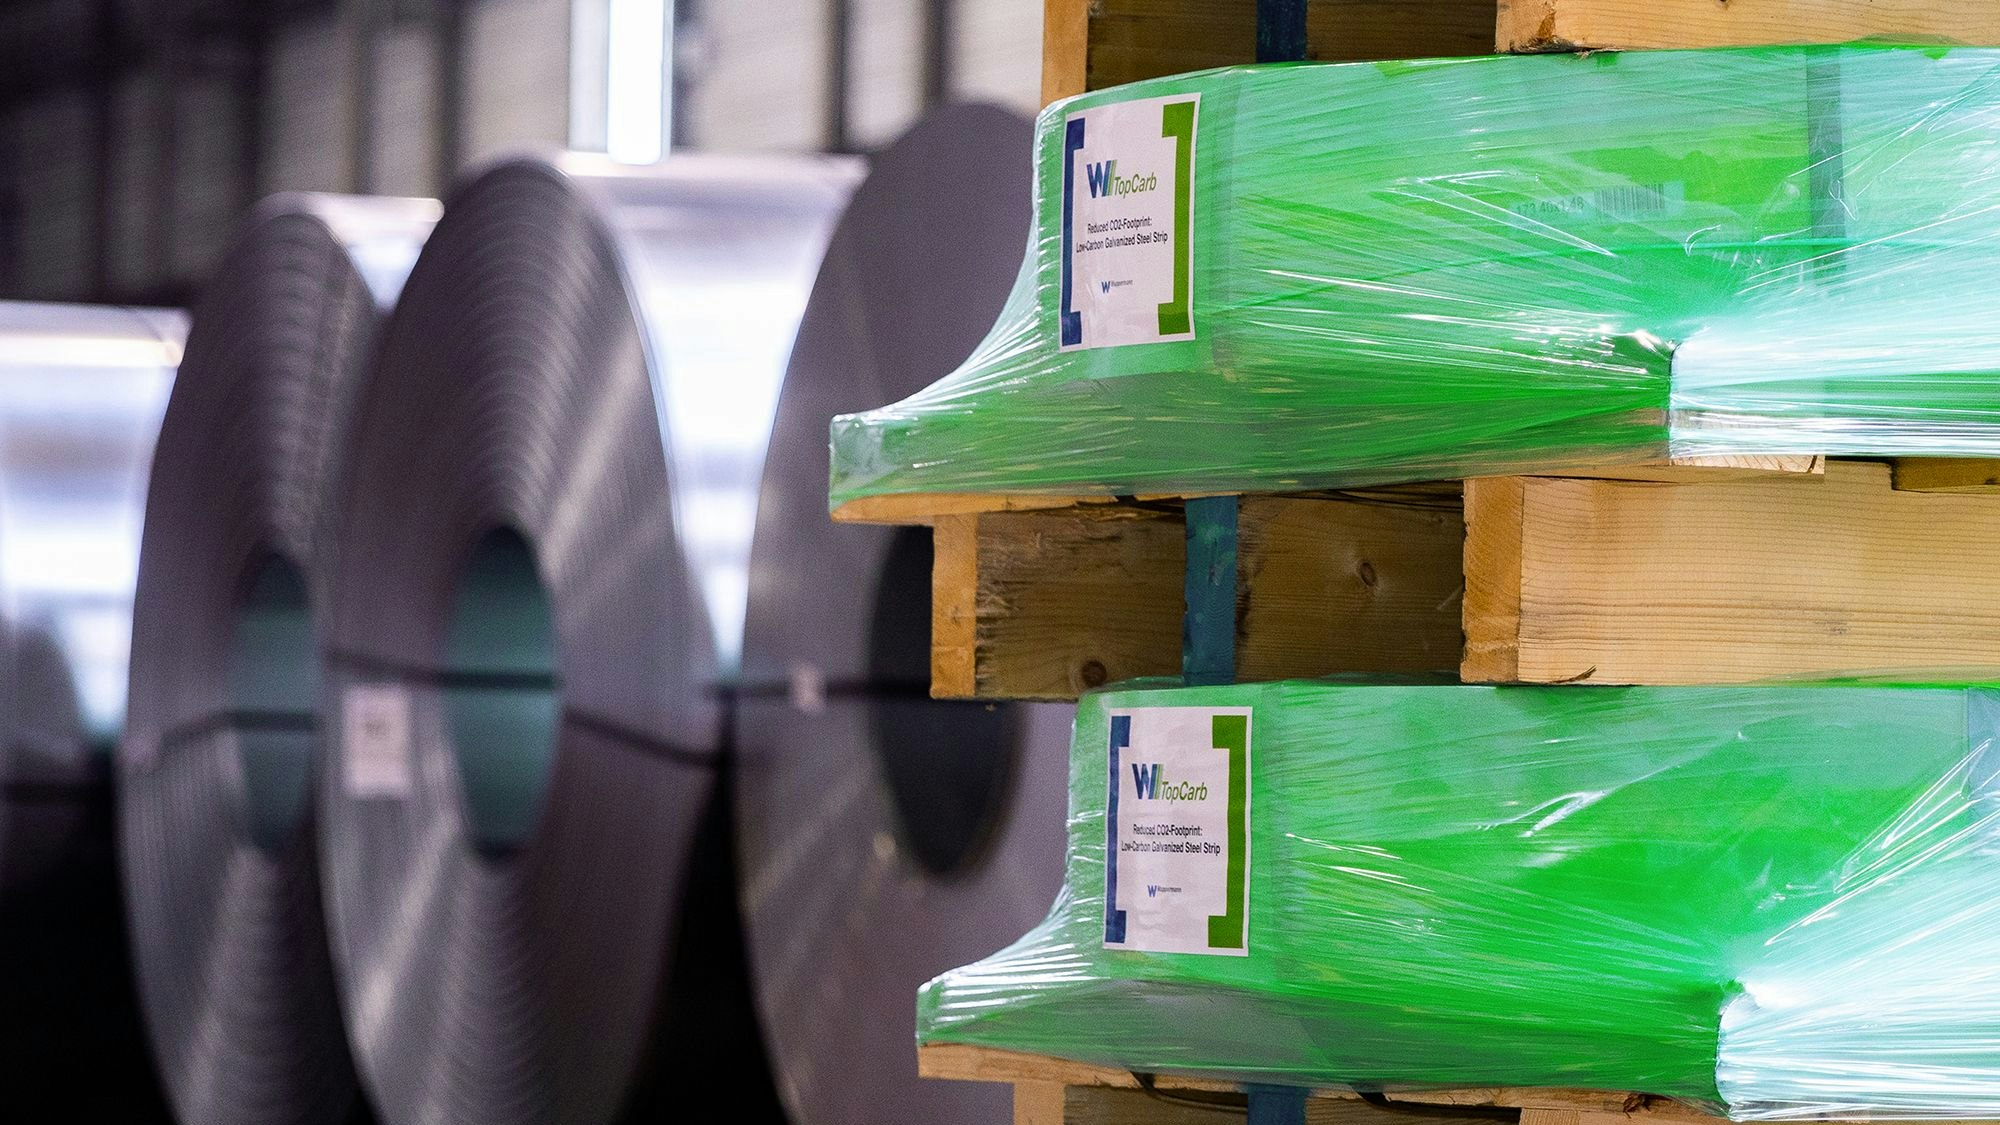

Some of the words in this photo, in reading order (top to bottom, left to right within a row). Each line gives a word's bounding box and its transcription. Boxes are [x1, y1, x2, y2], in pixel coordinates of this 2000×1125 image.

[1114, 171, 1157, 199] TopCarb
[1087, 222, 1109, 234] Reduced
[1109, 216, 1153, 231] CO2-Footprint:
[1076, 239, 1105, 253] Low-Carbon
[1104, 233, 1136, 249] Galvanized
[1136, 231, 1153, 245] Steel
[1152, 230, 1169, 244] Strip
[1161, 781, 1208, 805] TopCarb
[1133, 823, 1156, 835] Reduced
[1156, 824, 1203, 838] CO2-Footprint:
[1121, 841, 1151, 852] Low-Carbon
[1151, 841, 1184, 853] Galvanized
[1184, 841, 1202, 854] Steel
[1203, 841, 1221, 856] Strip
